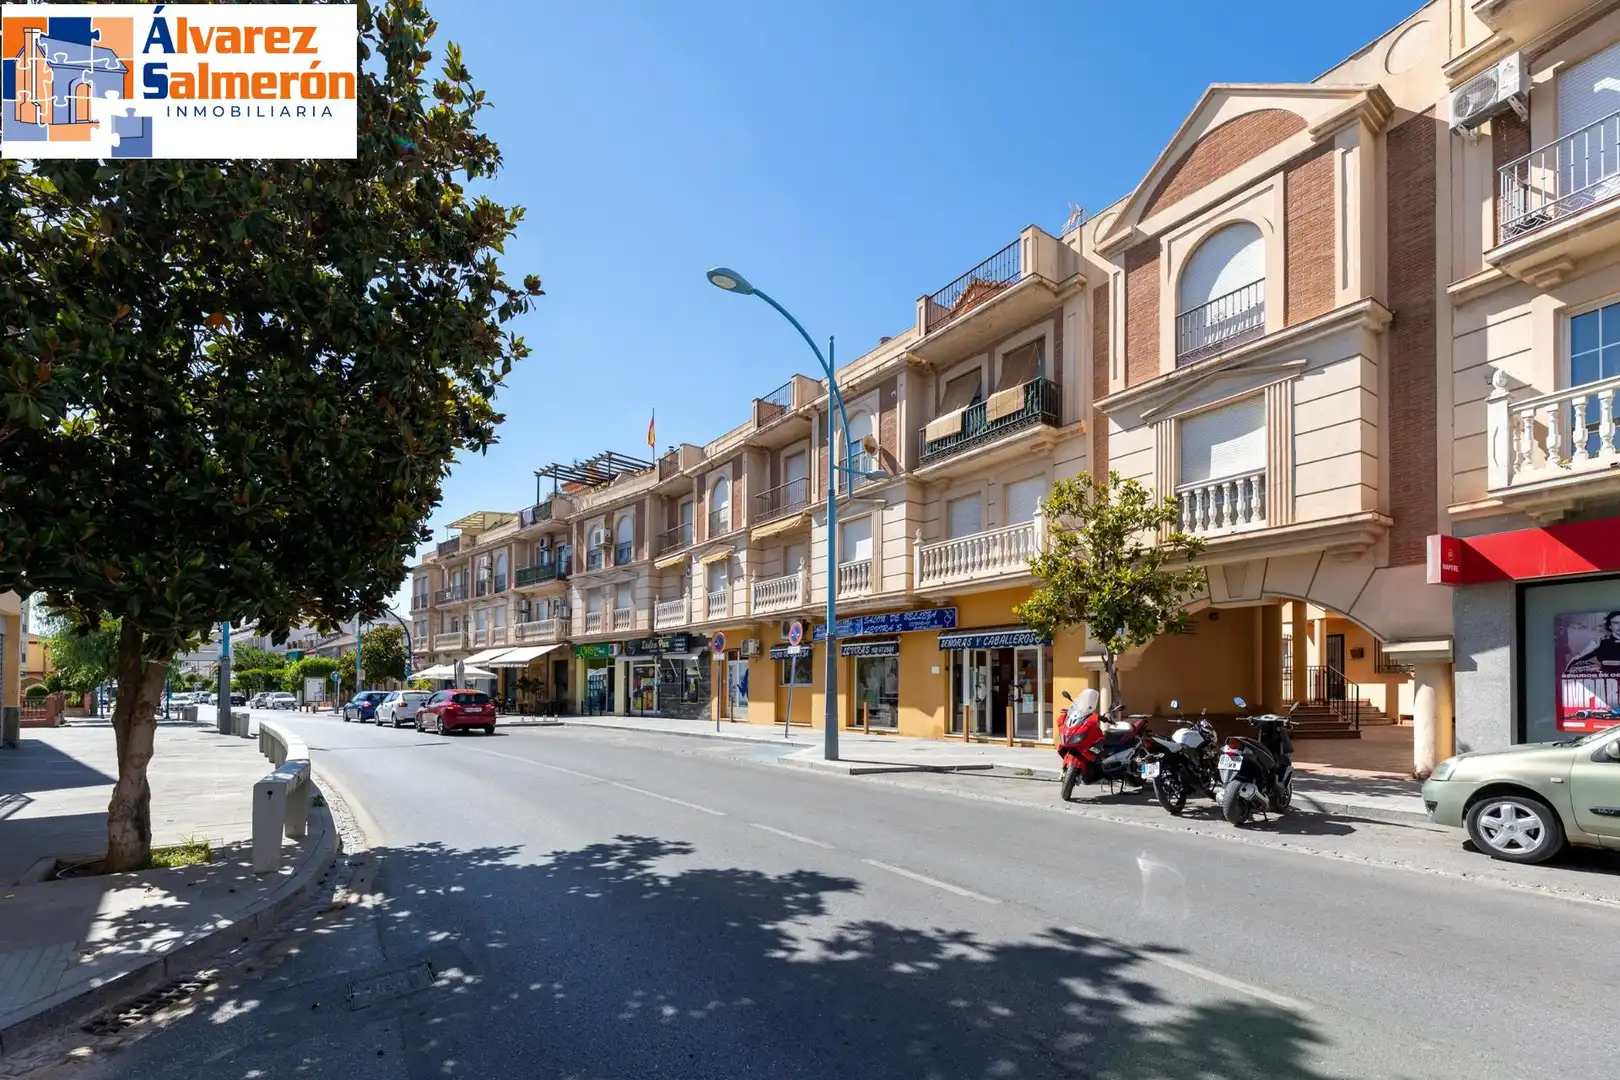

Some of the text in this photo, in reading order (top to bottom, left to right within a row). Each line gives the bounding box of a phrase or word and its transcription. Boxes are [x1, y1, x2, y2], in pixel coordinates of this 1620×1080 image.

[976, 636, 982, 646] Y
[983, 633, 1036, 646] CABALLEROS
[1561, 678, 1620, 709] IMPAR
